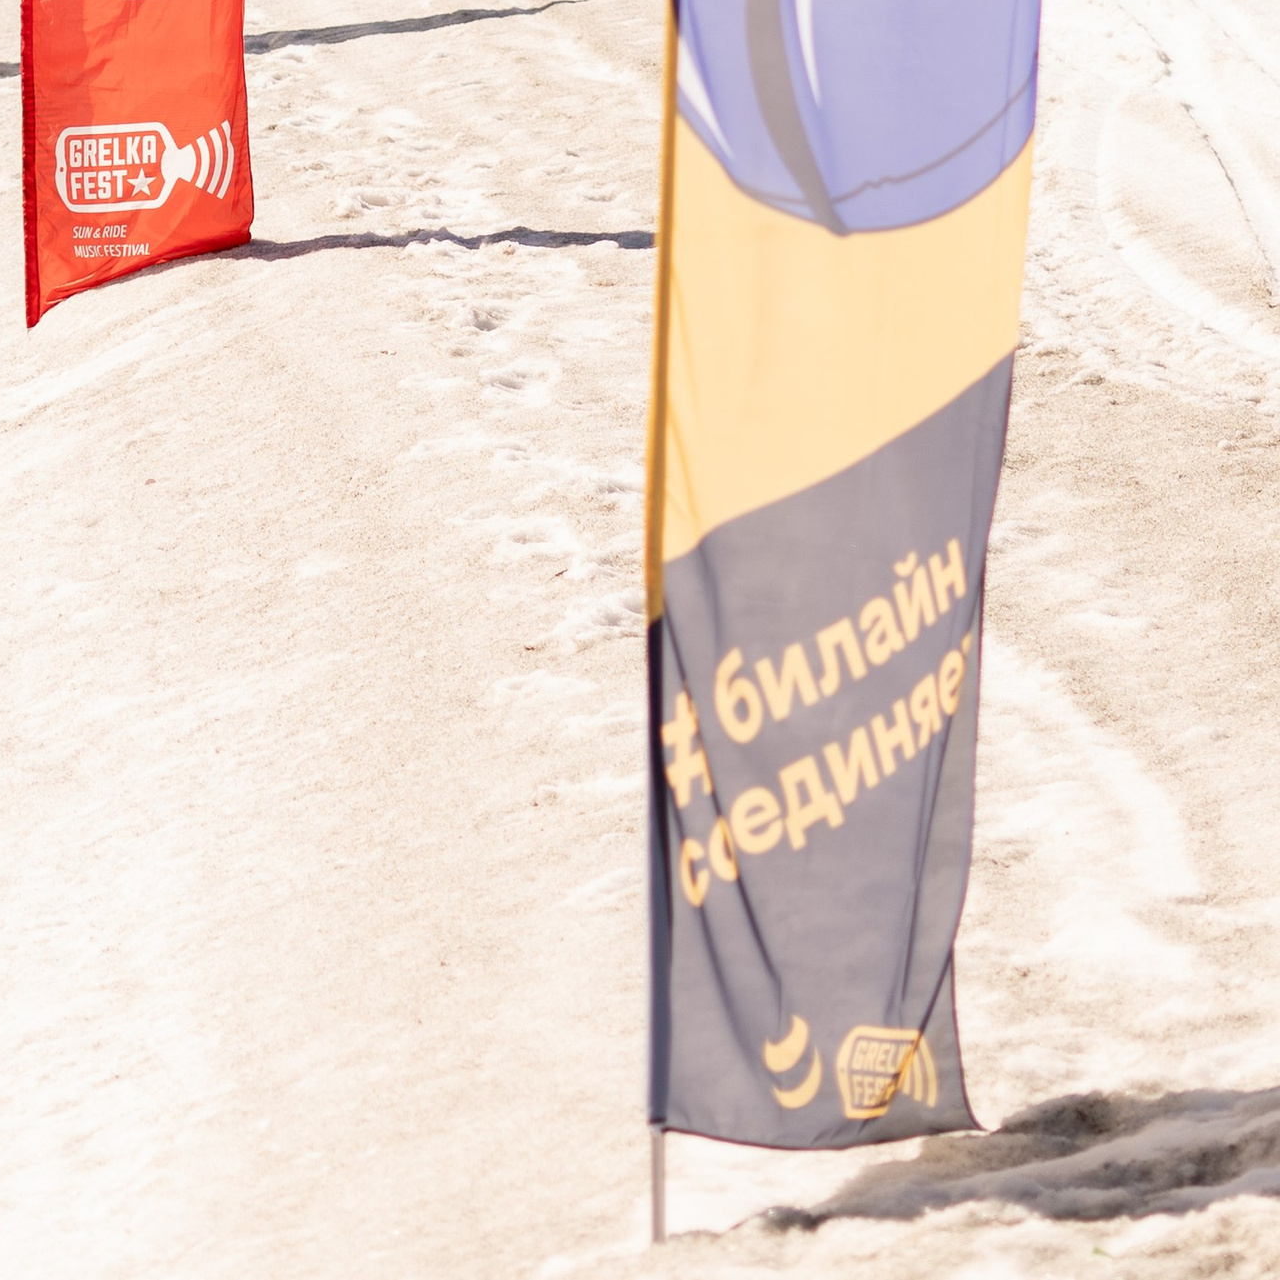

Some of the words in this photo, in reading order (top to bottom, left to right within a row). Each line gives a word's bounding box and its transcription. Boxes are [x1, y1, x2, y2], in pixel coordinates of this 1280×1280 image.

[70, 135, 157, 168] GRELKA
[70, 169, 128, 200] FEST
[73, 225, 93, 239] SUN
[92, 227, 101, 239] &
[102, 224, 128, 238] RIDE
[74, 244, 104, 258] MUSIC
[103, 242, 151, 258] FESTIVAL
[714, 537, 968, 745] билайн
[679, 632, 973, 908] соединяе
